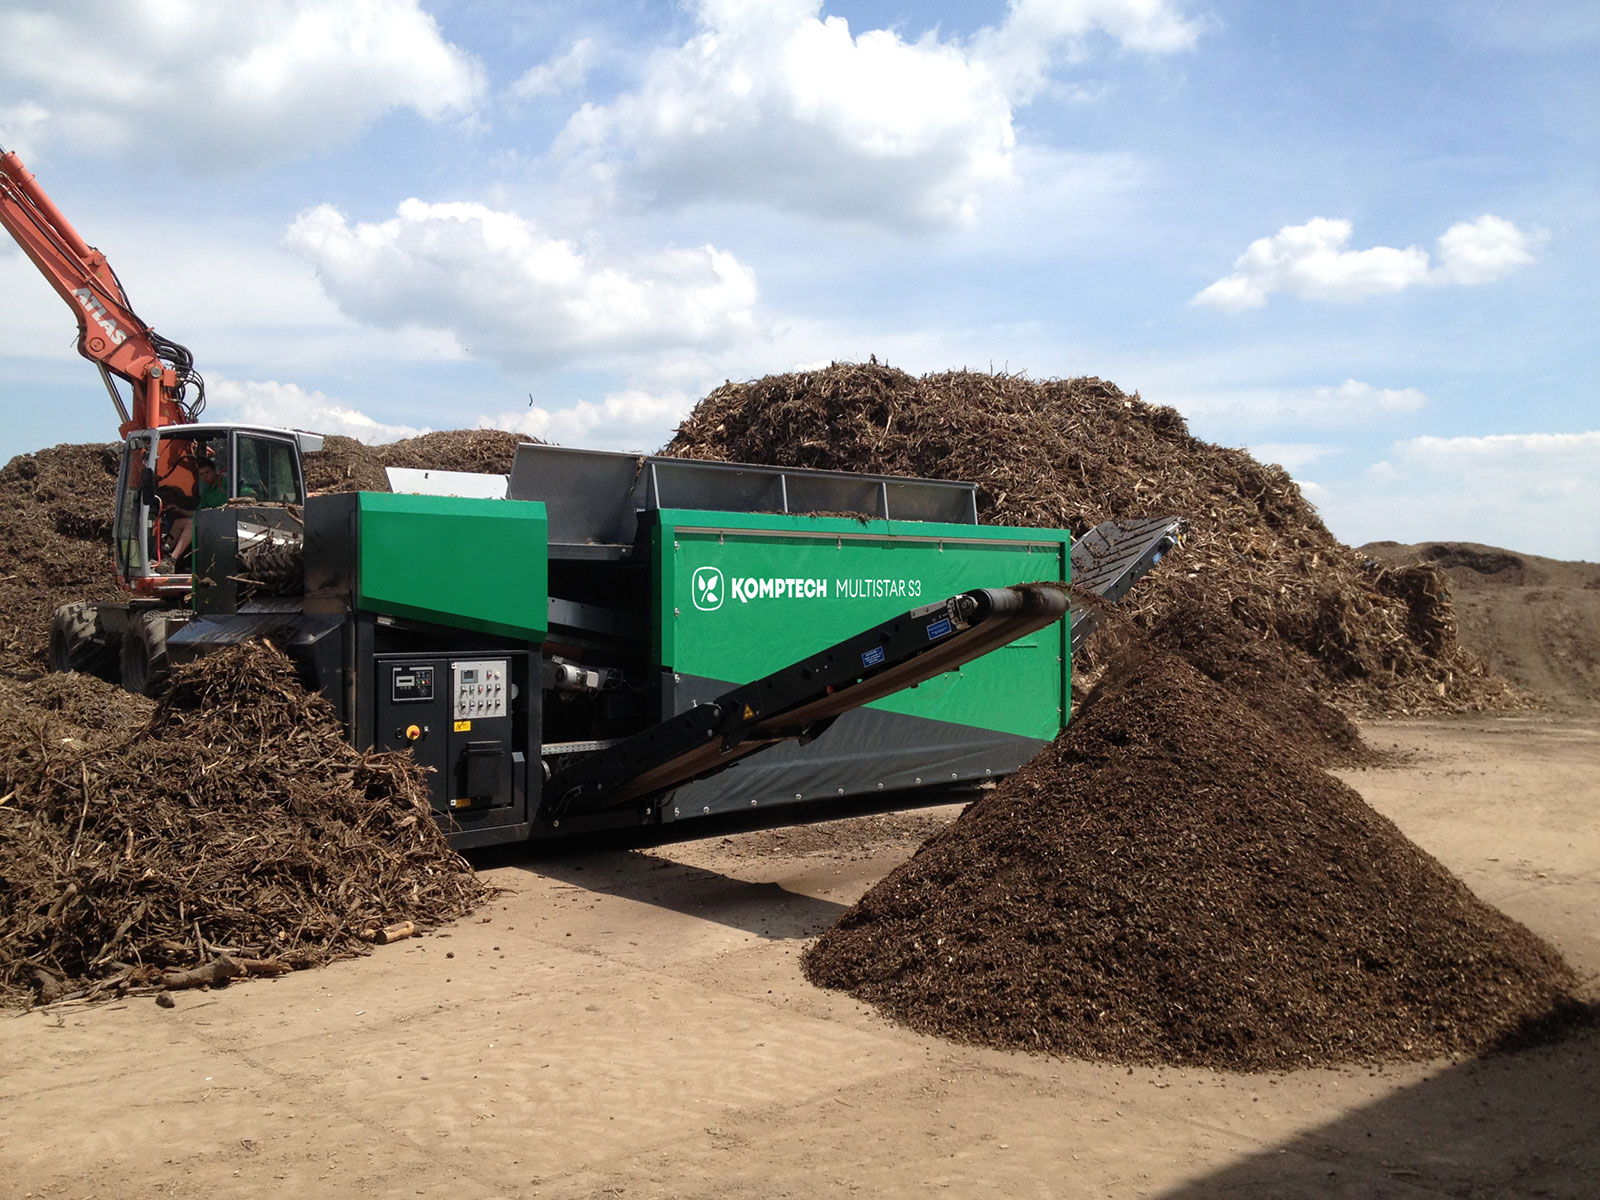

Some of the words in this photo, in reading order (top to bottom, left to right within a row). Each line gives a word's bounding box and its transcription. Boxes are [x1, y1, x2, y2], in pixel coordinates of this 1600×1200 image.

[72, 287, 127, 345] ATLAS
[731, 577, 827, 604] KOMPTECH
[835, 578, 905, 598] MULTISTAR
[908, 579, 922, 597] S3
